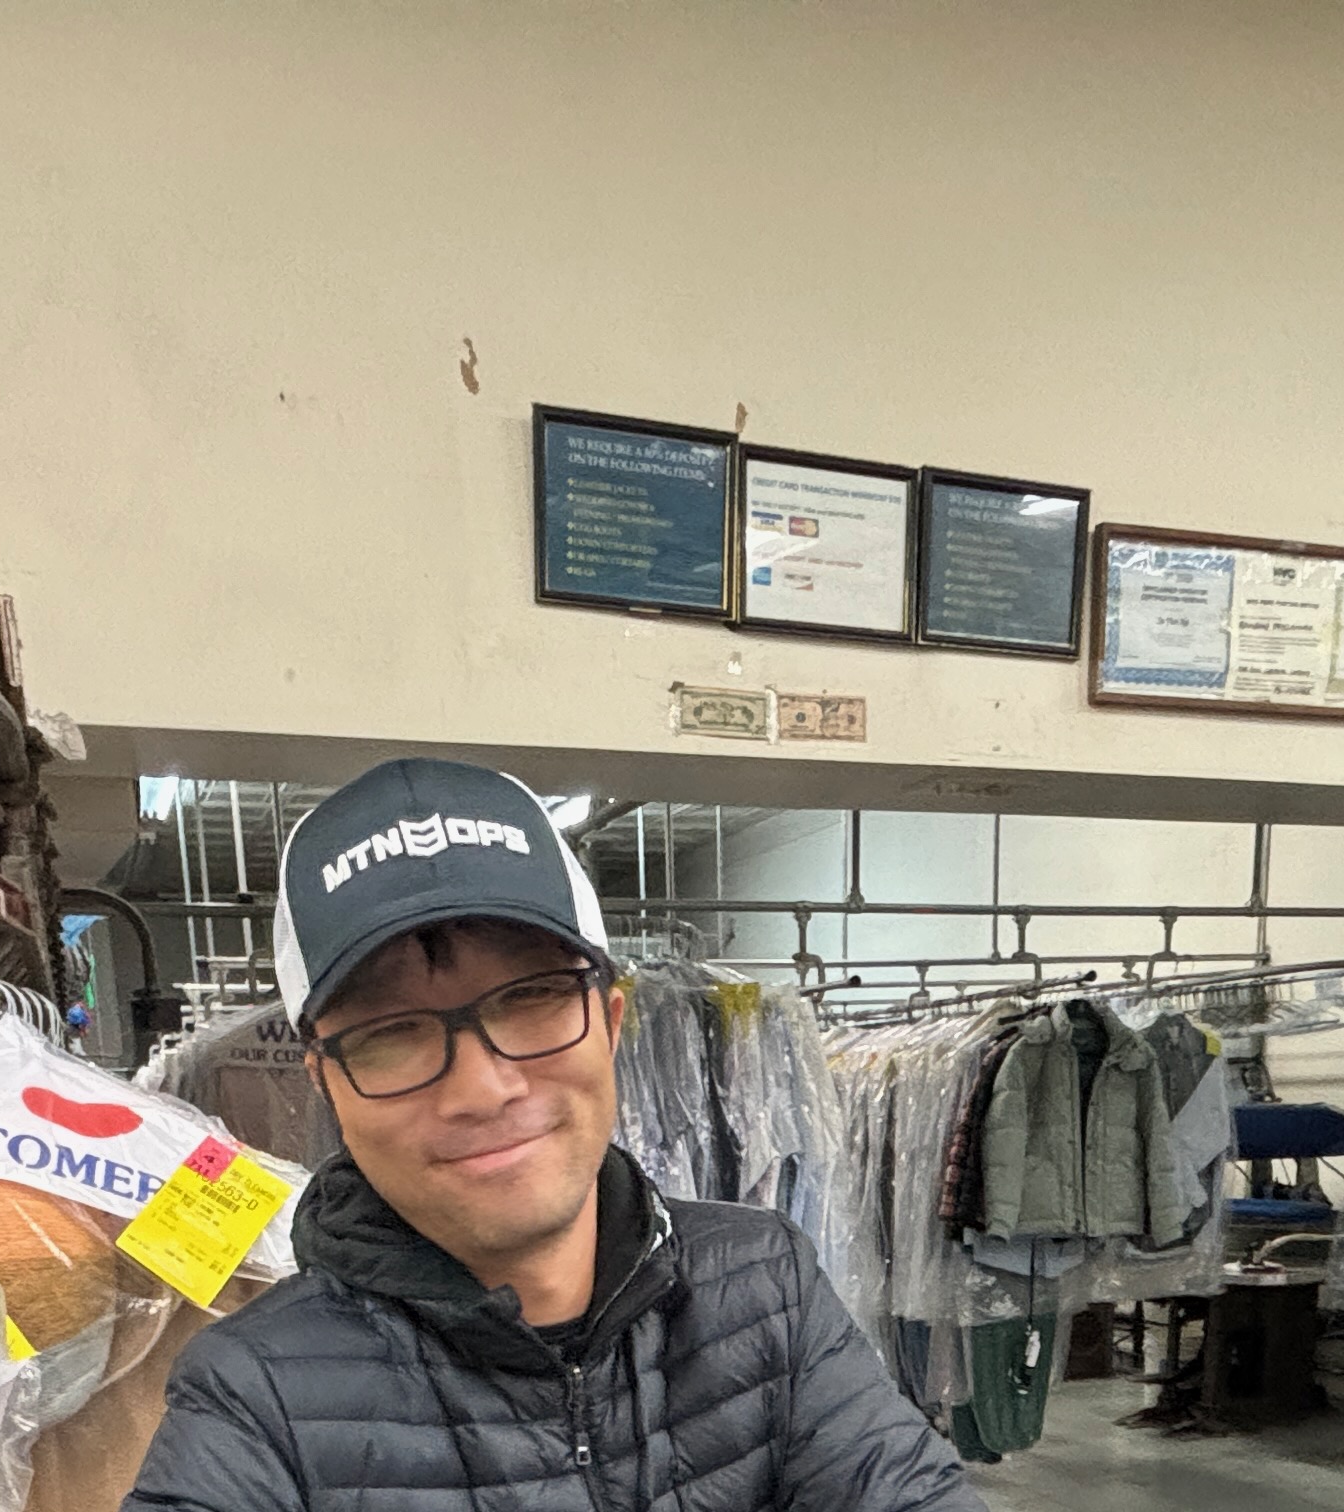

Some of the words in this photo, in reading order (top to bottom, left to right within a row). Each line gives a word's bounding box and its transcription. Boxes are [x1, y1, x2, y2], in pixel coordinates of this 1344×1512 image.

[779, 480, 800, 492] CARD
[321, 827, 404, 893] MTN
[444, 817, 531, 856] OPS
